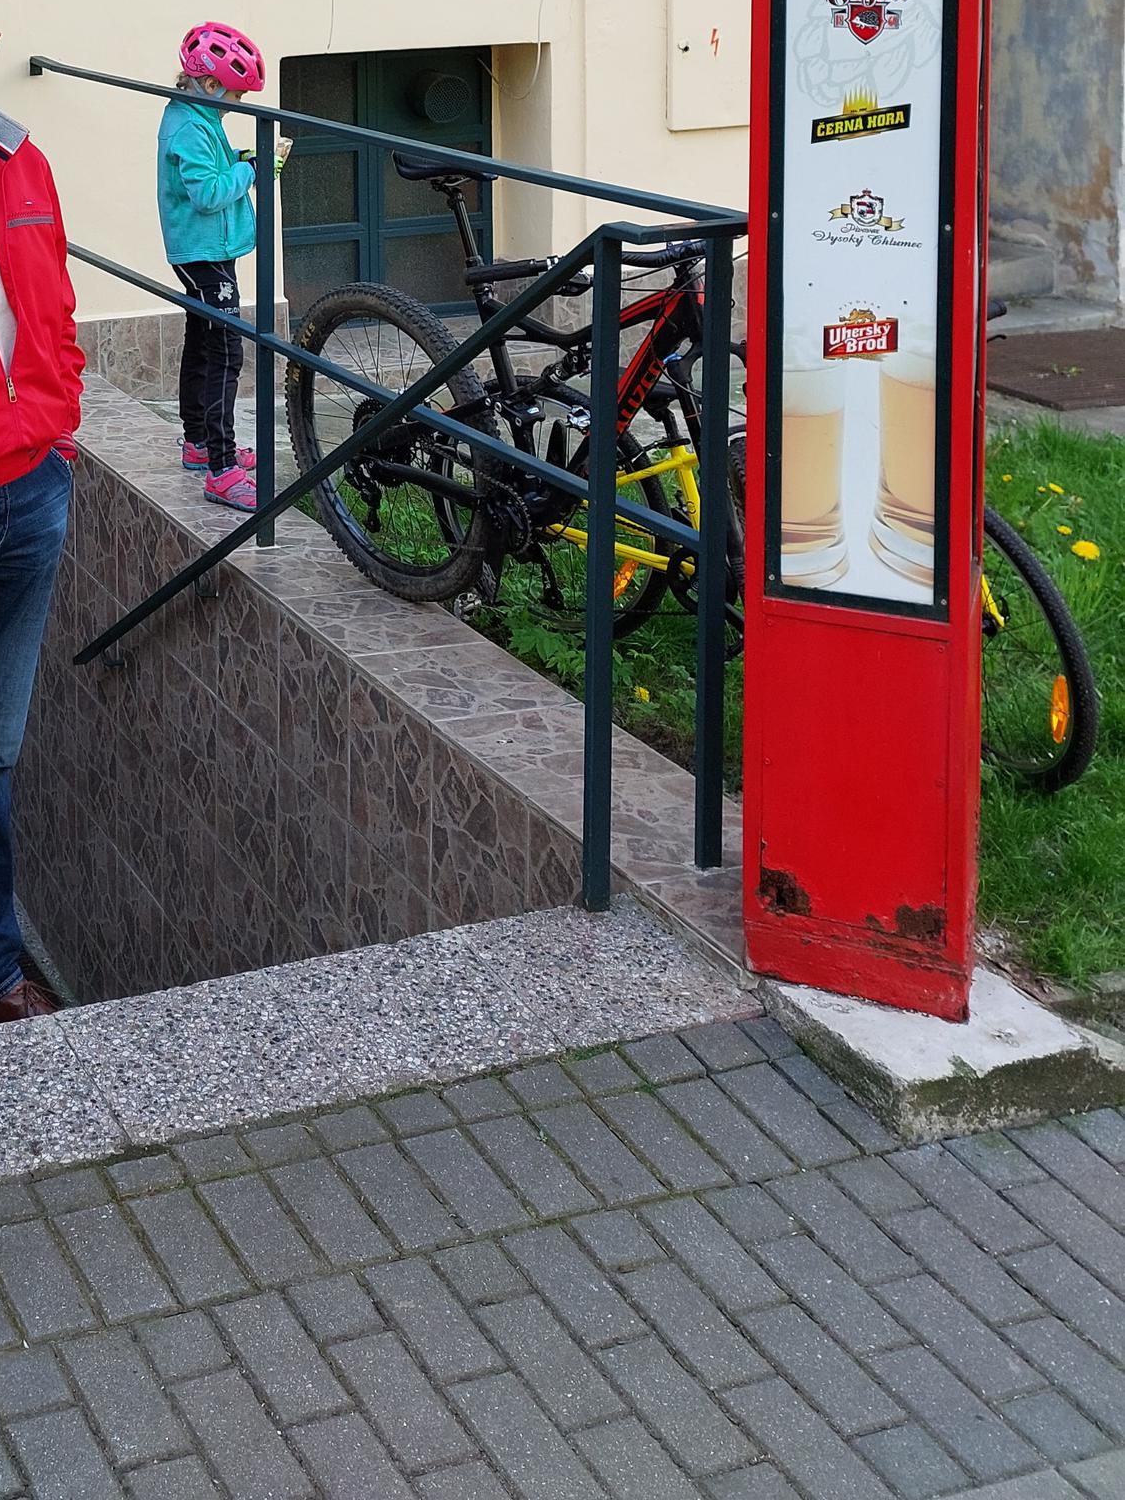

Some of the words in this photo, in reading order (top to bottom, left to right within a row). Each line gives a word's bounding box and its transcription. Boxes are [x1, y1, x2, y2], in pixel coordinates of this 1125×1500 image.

[817, 114, 864, 137] ČERNÁ
[867, 110, 905, 128] HORA
[829, 322, 892, 345] Uherský
[845, 335, 888, 354] Brod
